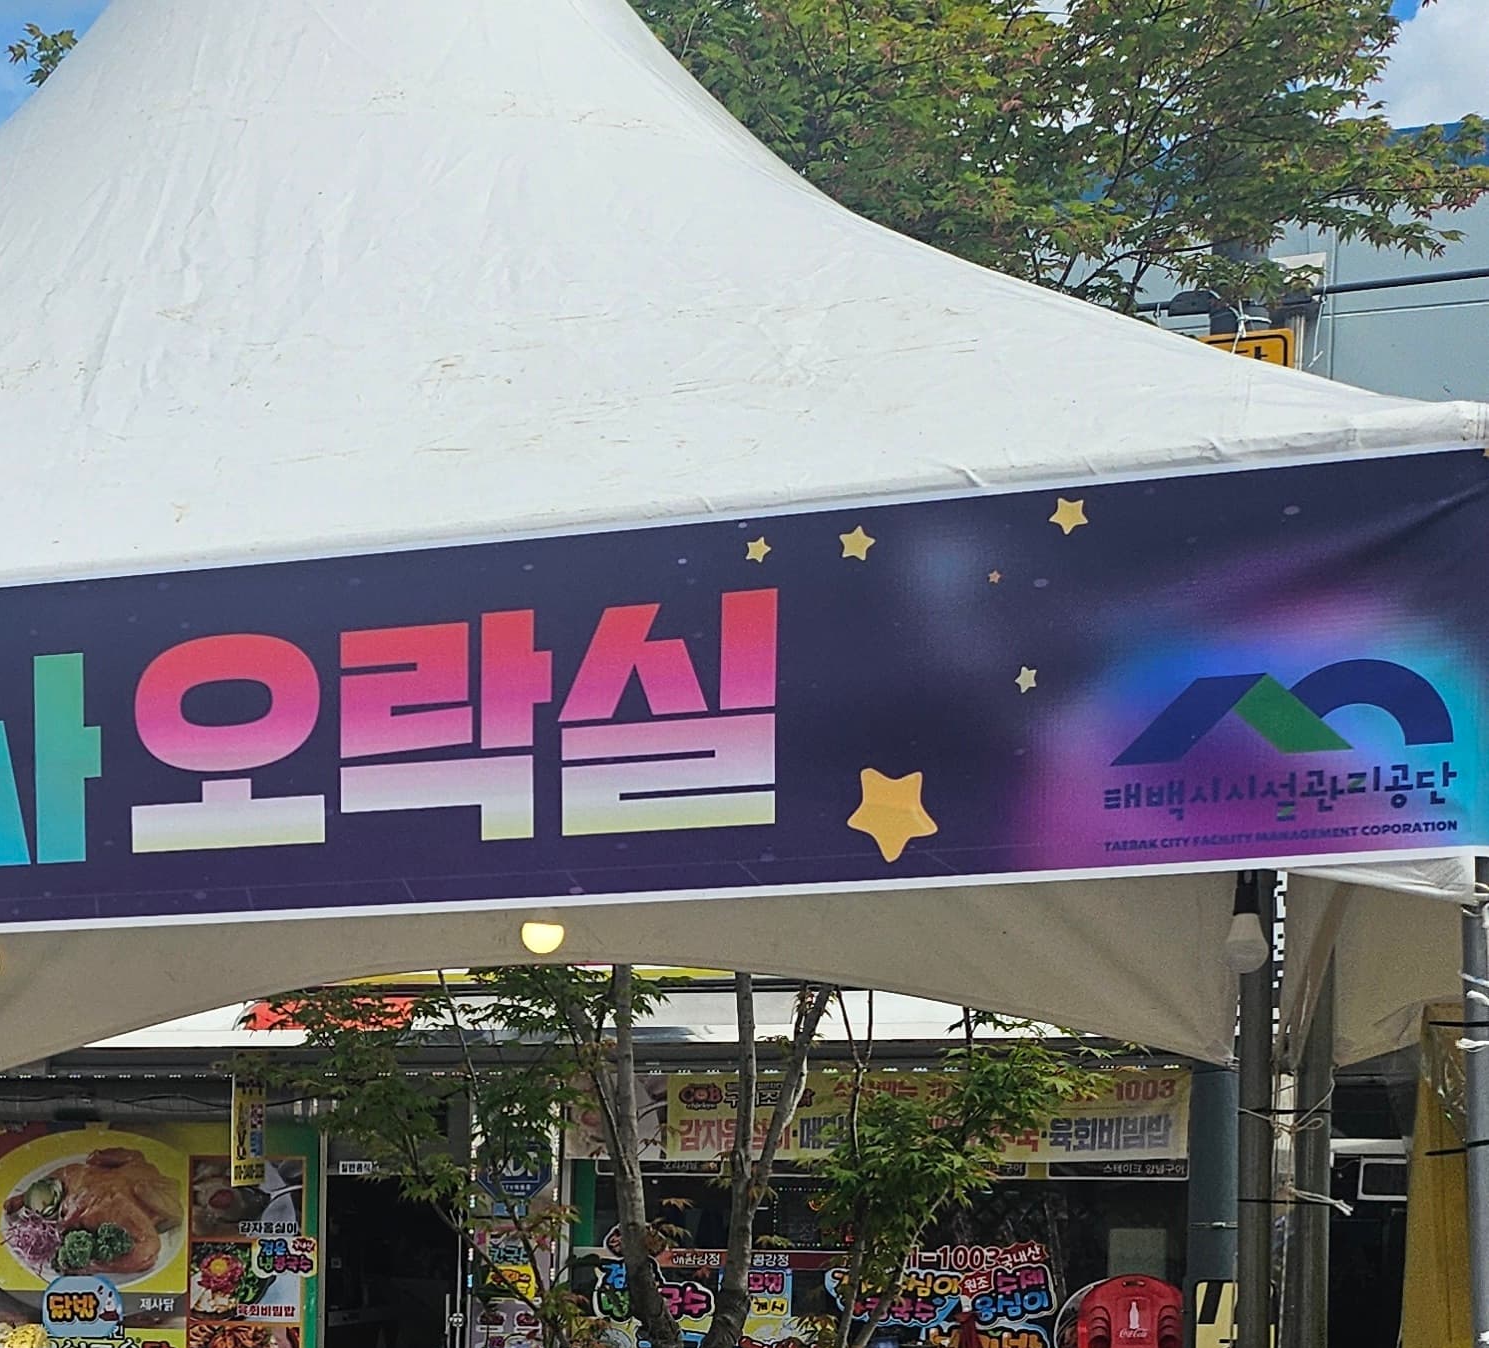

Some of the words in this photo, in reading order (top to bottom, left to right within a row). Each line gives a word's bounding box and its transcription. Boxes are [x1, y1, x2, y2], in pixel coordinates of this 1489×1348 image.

[131, 587, 778, 854] 오락실
[1104, 761, 1457, 822] 태백시시설관리공단
[1161, 835, 1189, 849] CITY
[1192, 831, 1254, 847] FACILITY
[1256, 826, 1357, 843] MANAGEMENT
[1361, 820, 1458, 836] COPORATION
